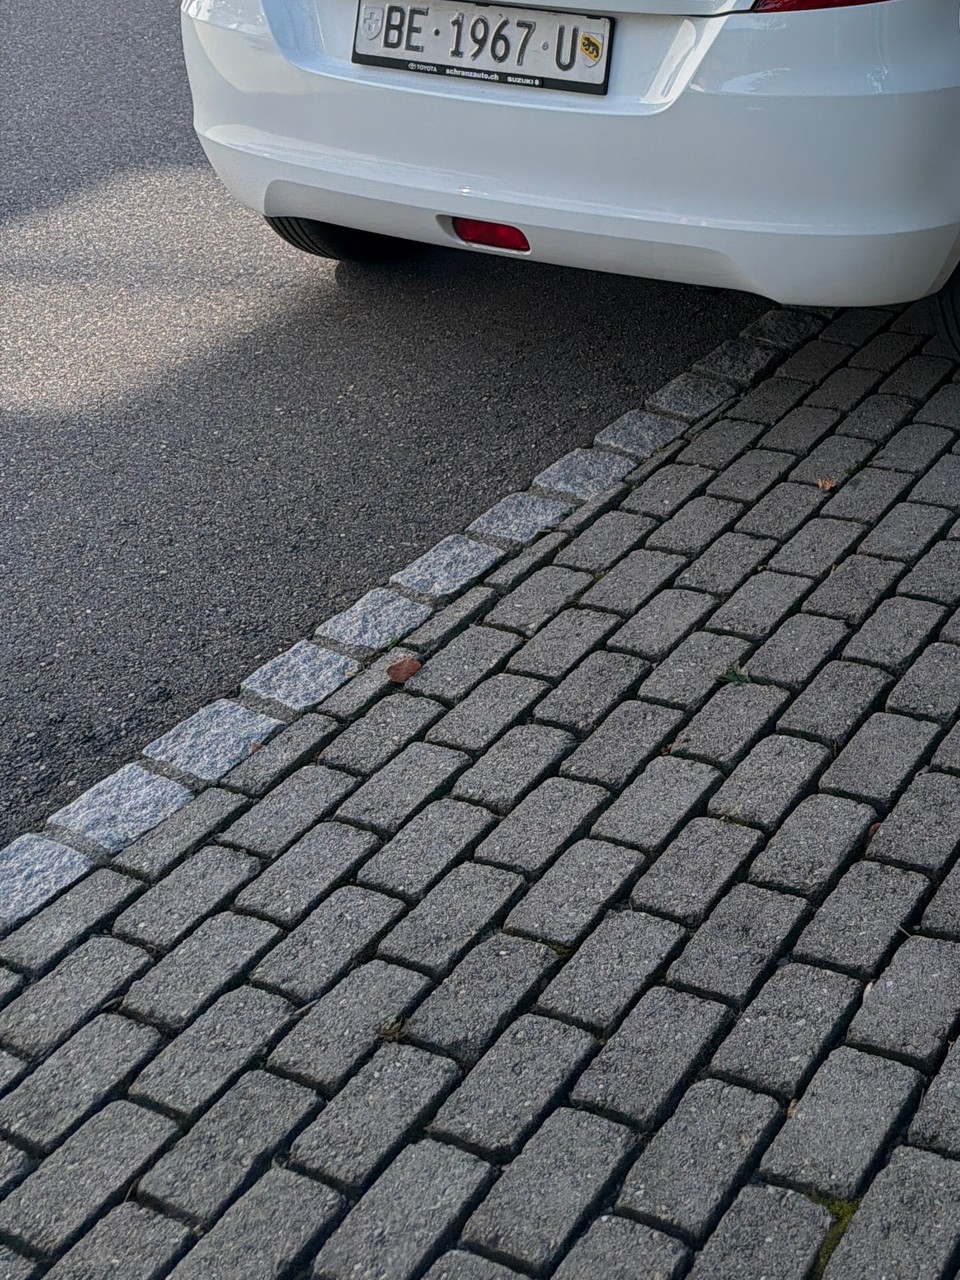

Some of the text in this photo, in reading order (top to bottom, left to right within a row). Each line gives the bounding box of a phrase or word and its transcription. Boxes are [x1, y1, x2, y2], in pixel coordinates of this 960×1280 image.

[382, 3, 579, 71] BE 1967 U
[416, 65, 534, 85] TOYOTA schranzauto.ch SUZUKI
